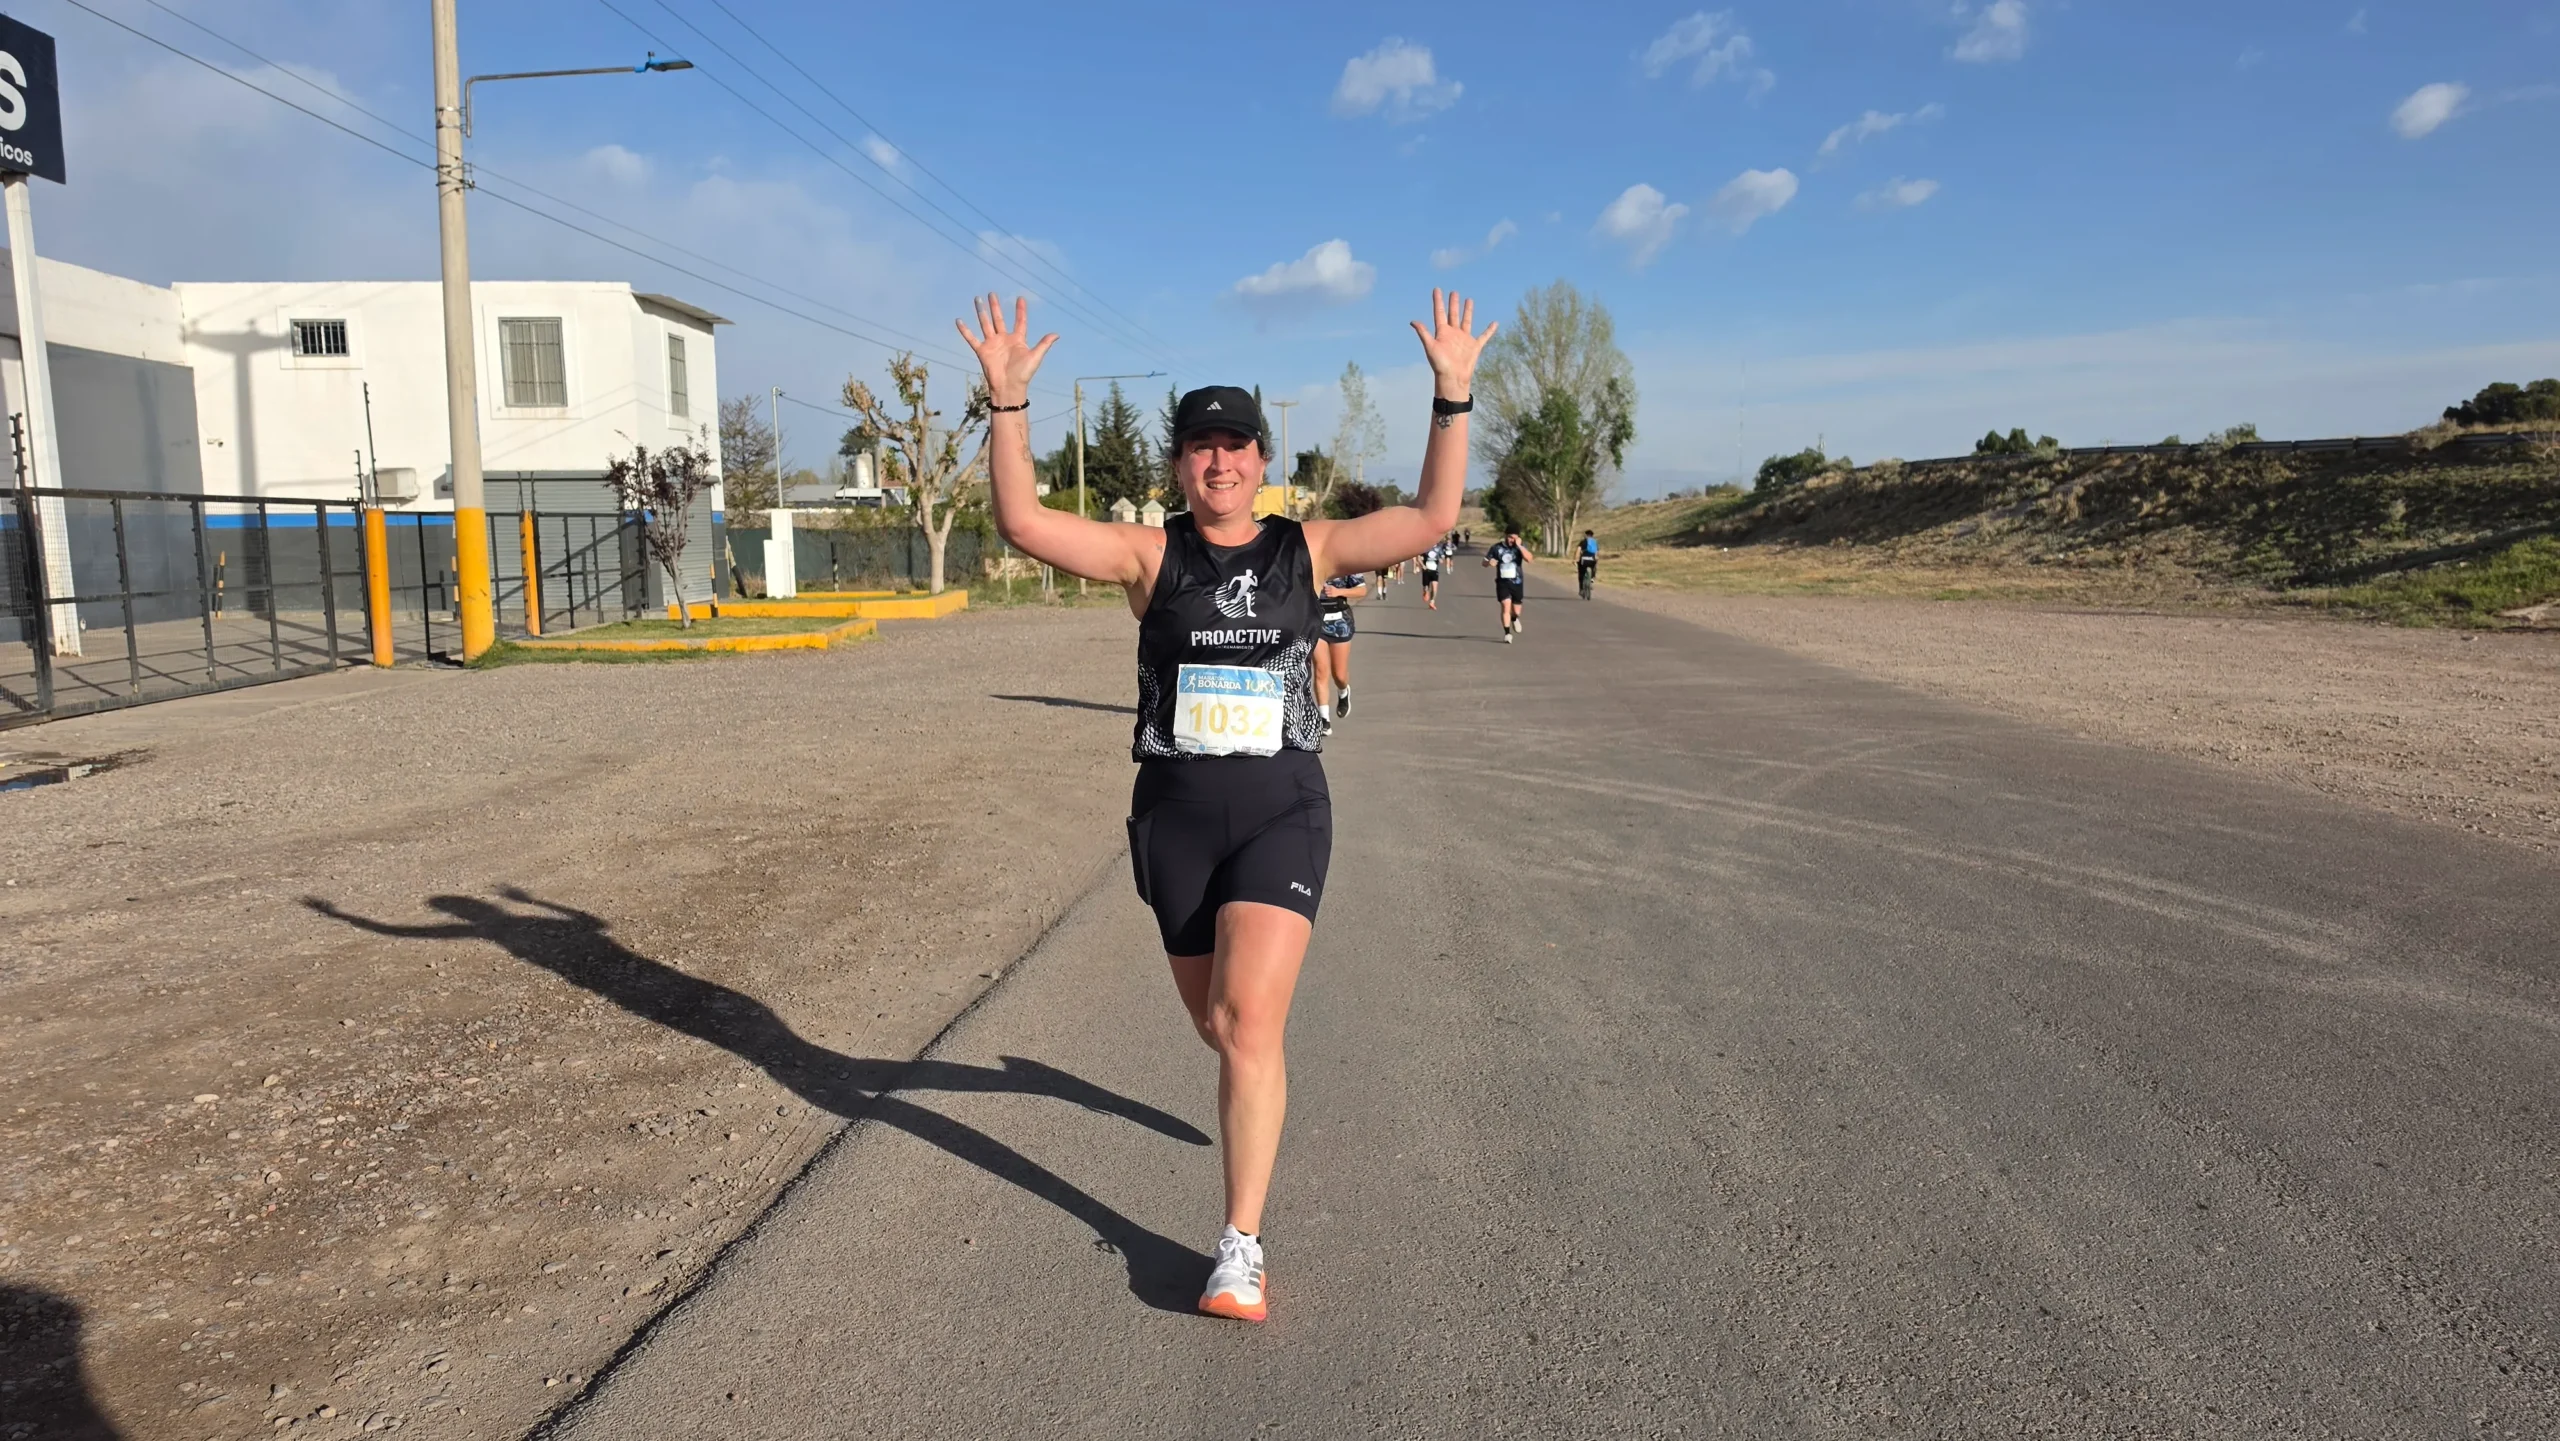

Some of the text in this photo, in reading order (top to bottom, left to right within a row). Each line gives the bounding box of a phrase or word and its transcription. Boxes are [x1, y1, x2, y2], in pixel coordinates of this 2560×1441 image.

[1191, 629, 1281, 646] PROACTIVE
[1197, 679, 1242, 690] BONARDA
[1189, 702, 1272, 737] 1032
[1290, 881, 1312, 897] FILA
